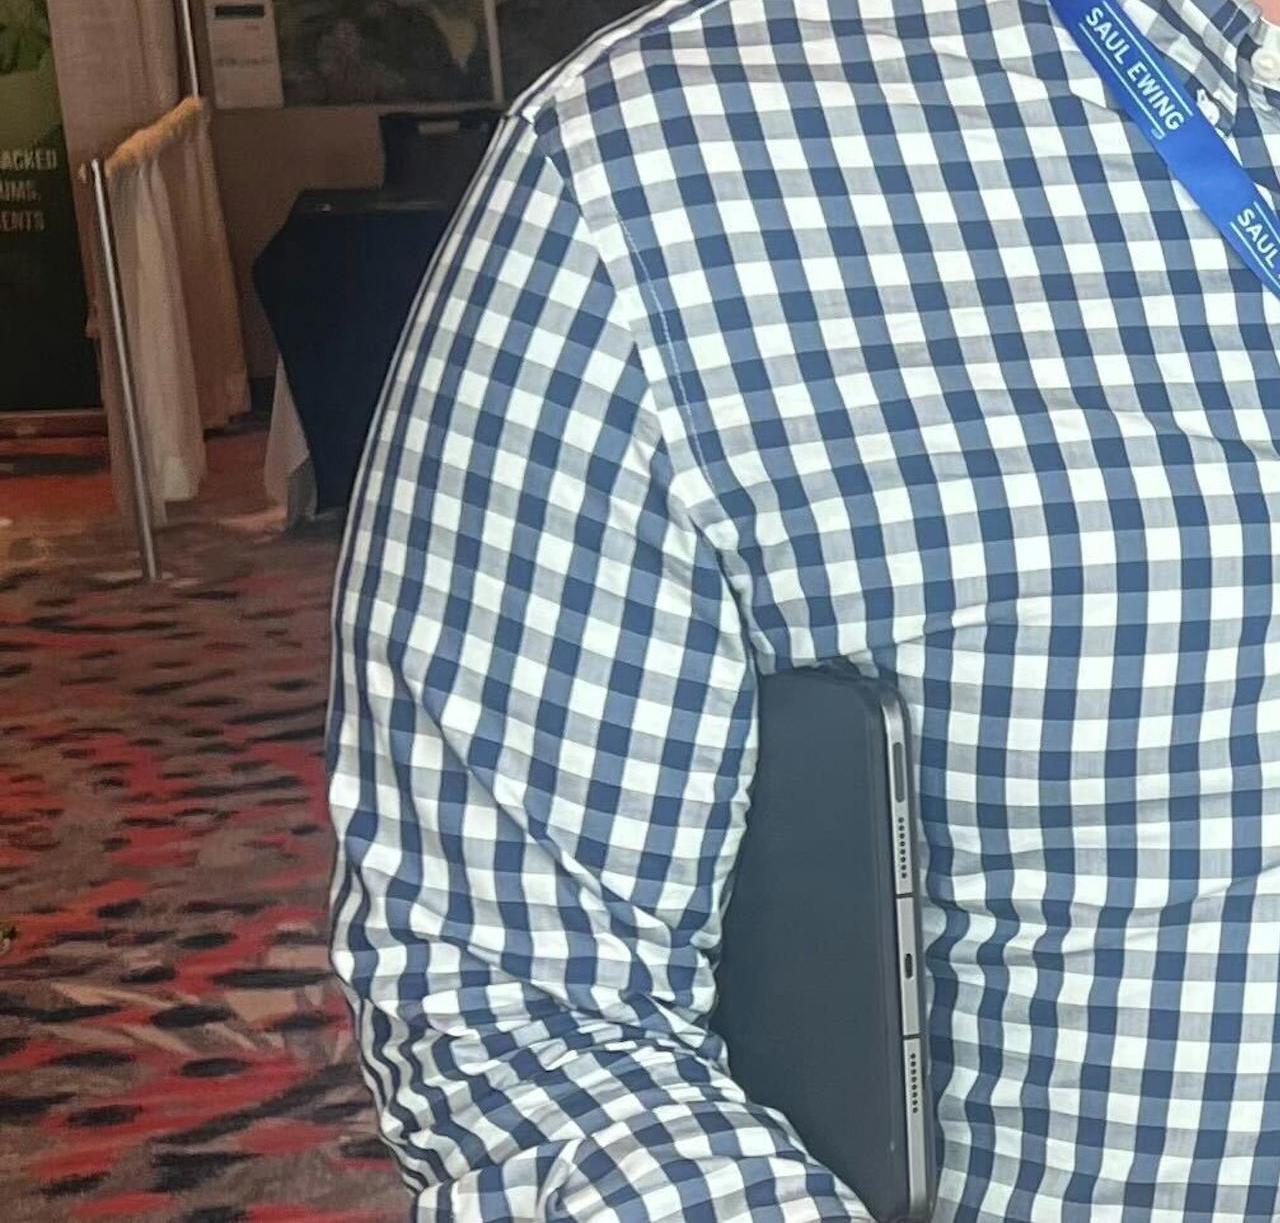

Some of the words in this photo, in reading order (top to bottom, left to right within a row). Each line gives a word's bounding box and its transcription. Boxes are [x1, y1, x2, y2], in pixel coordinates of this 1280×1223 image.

[1086, 7, 1134, 66] SAUL
[1127, 62, 1185, 130] EWING
[1237, 209, 1278, 268] SAUL
